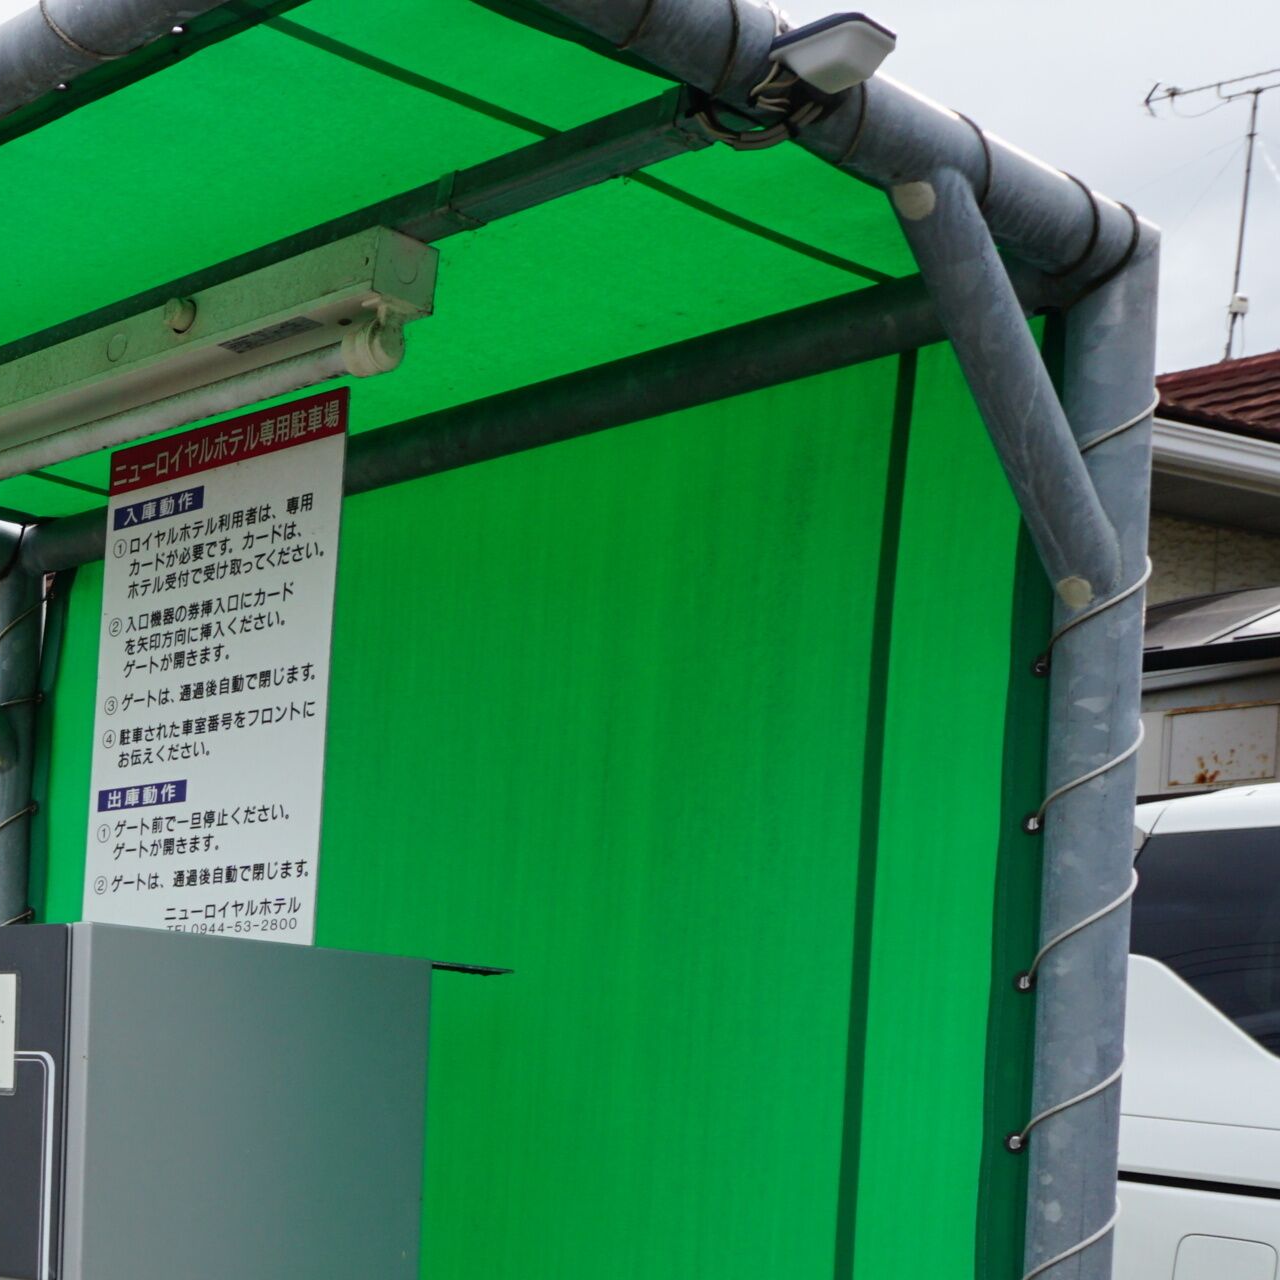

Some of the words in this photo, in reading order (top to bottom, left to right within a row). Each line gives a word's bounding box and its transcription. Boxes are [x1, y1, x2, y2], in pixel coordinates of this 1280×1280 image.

[113, 400, 340, 486] ニューロイヤルホテル専用駐車場
[124, 492, 194, 526] 入庫動作
[127, 541, 325, 599] ホテル受付で受け取ってください。
[125, 611, 285, 655] を矢印方向に挿入ください。
[123, 644, 230, 678] ゲートが開きます。
[118, 741, 210, 768] お伝えください。
[107, 783, 176, 809] 出庫動作
[113, 834, 219, 860] ゲートが開きます。
[164, 896, 301, 920] ニューロイヤルホテル
